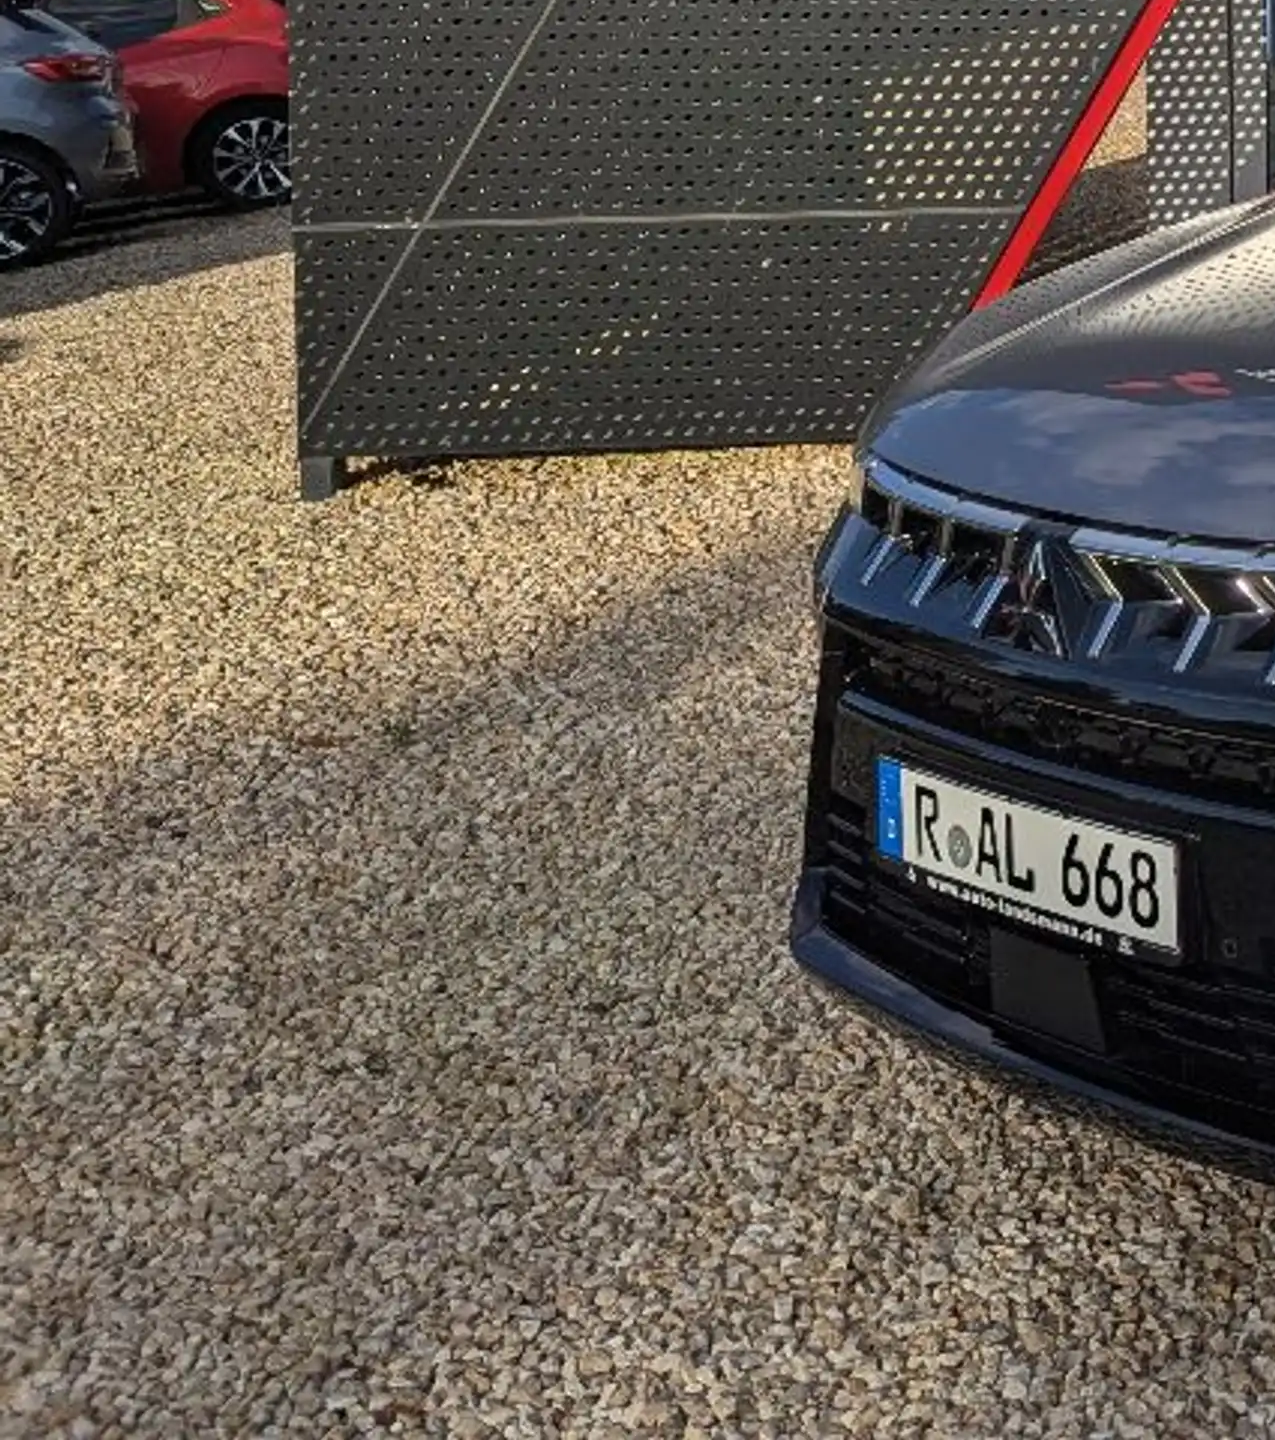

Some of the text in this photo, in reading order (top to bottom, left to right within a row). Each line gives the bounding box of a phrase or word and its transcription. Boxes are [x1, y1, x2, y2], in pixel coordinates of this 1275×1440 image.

[915, 784, 1160, 929] R AL 668
